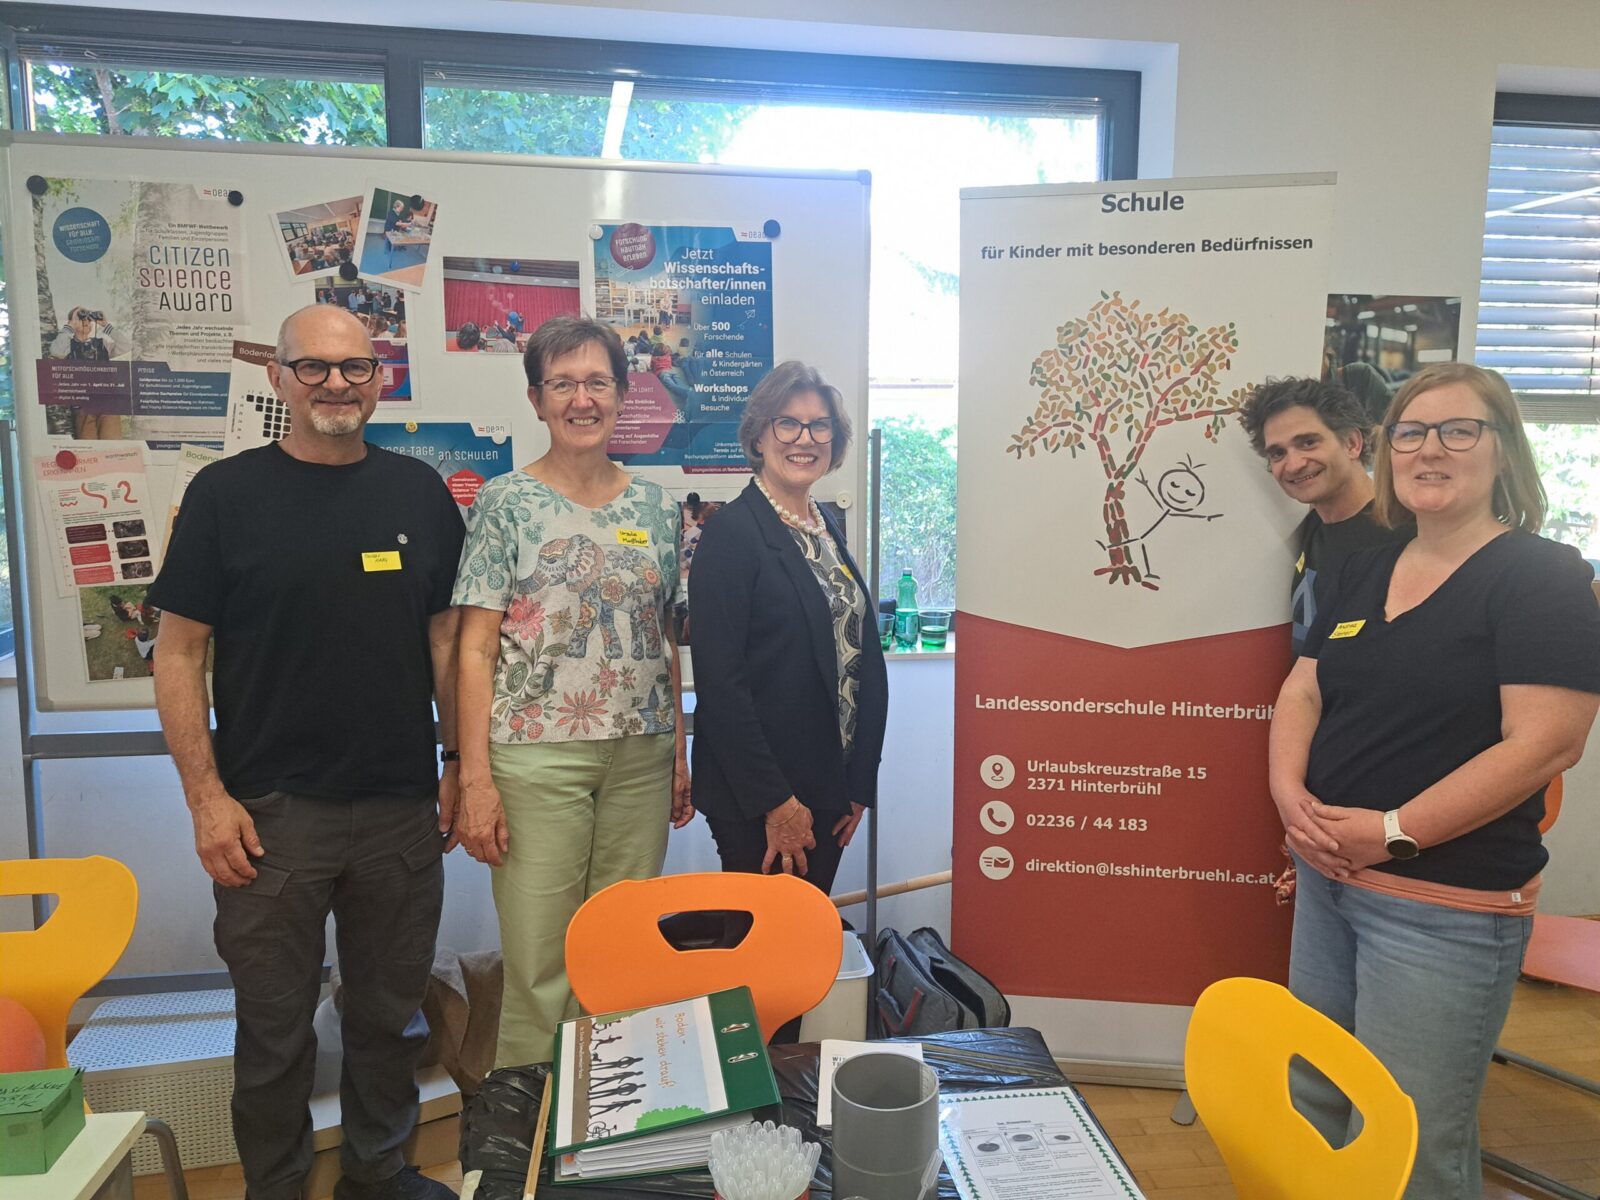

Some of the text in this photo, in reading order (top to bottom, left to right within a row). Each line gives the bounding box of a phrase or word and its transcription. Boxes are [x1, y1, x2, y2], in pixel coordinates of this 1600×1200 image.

[1101, 191, 1185, 213] Schule
[681, 248, 714, 260] Jetzt
[981, 236, 1313, 260] für Kinder mit besonderen Bedürfnissen
[664, 261, 765, 275] Wissenschafts-
[650, 277, 766, 290] botschafter/innen
[701, 293, 755, 305] einladen
[694, 322, 730, 331] Über 500
[704, 333, 744, 341] Forschende
[239, 347, 276, 359] Bodenfar
[706, 349, 724, 358] alle
[719, 361, 763, 369] Kindergärten
[709, 369, 744, 377] Österreich
[694, 384, 748, 394] Workshops
[975, 694, 1276, 720] Landessonderschule Hinterbrüh
[1027, 760, 1207, 780] Urlaubskreuzstraße 15
[1027, 778, 1161, 796] 2371 Hinterbrühl
[1026, 814, 1148, 832] 02236 / 44 183
[1026, 858, 1276, 885] direktion@lsshinterbruehl.ac.at
